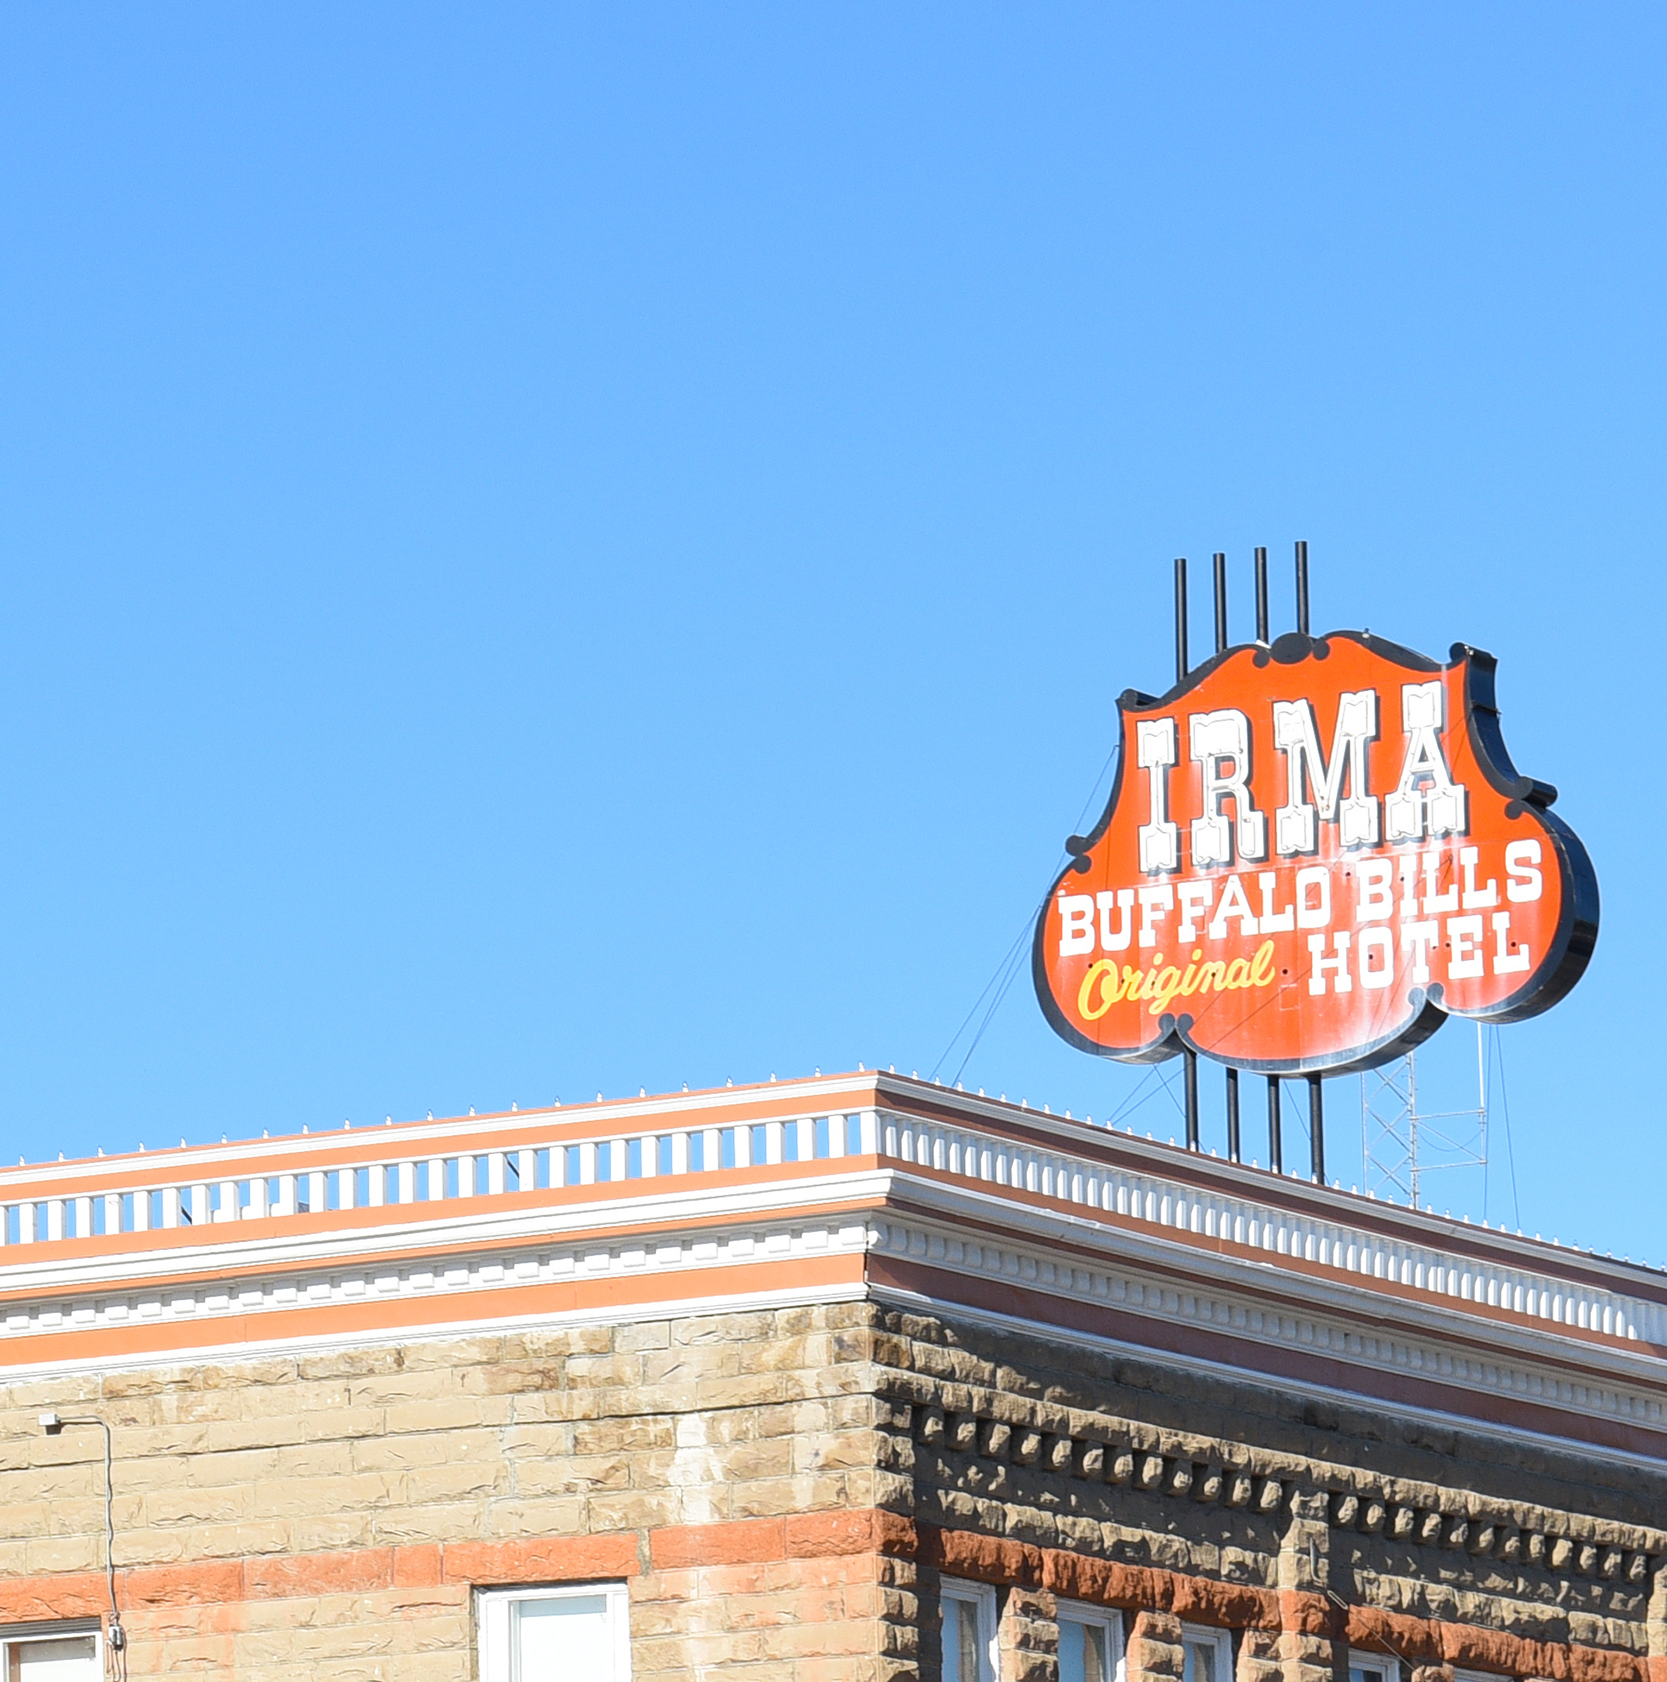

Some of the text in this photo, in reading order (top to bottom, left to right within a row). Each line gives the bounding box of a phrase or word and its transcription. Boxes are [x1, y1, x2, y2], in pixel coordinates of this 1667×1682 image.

[1136, 680, 1467, 873] IRMA
[1057, 838, 1543, 957] BUFFALO BILLS
[1077, 911, 1530, 1020] Original HOTEL
